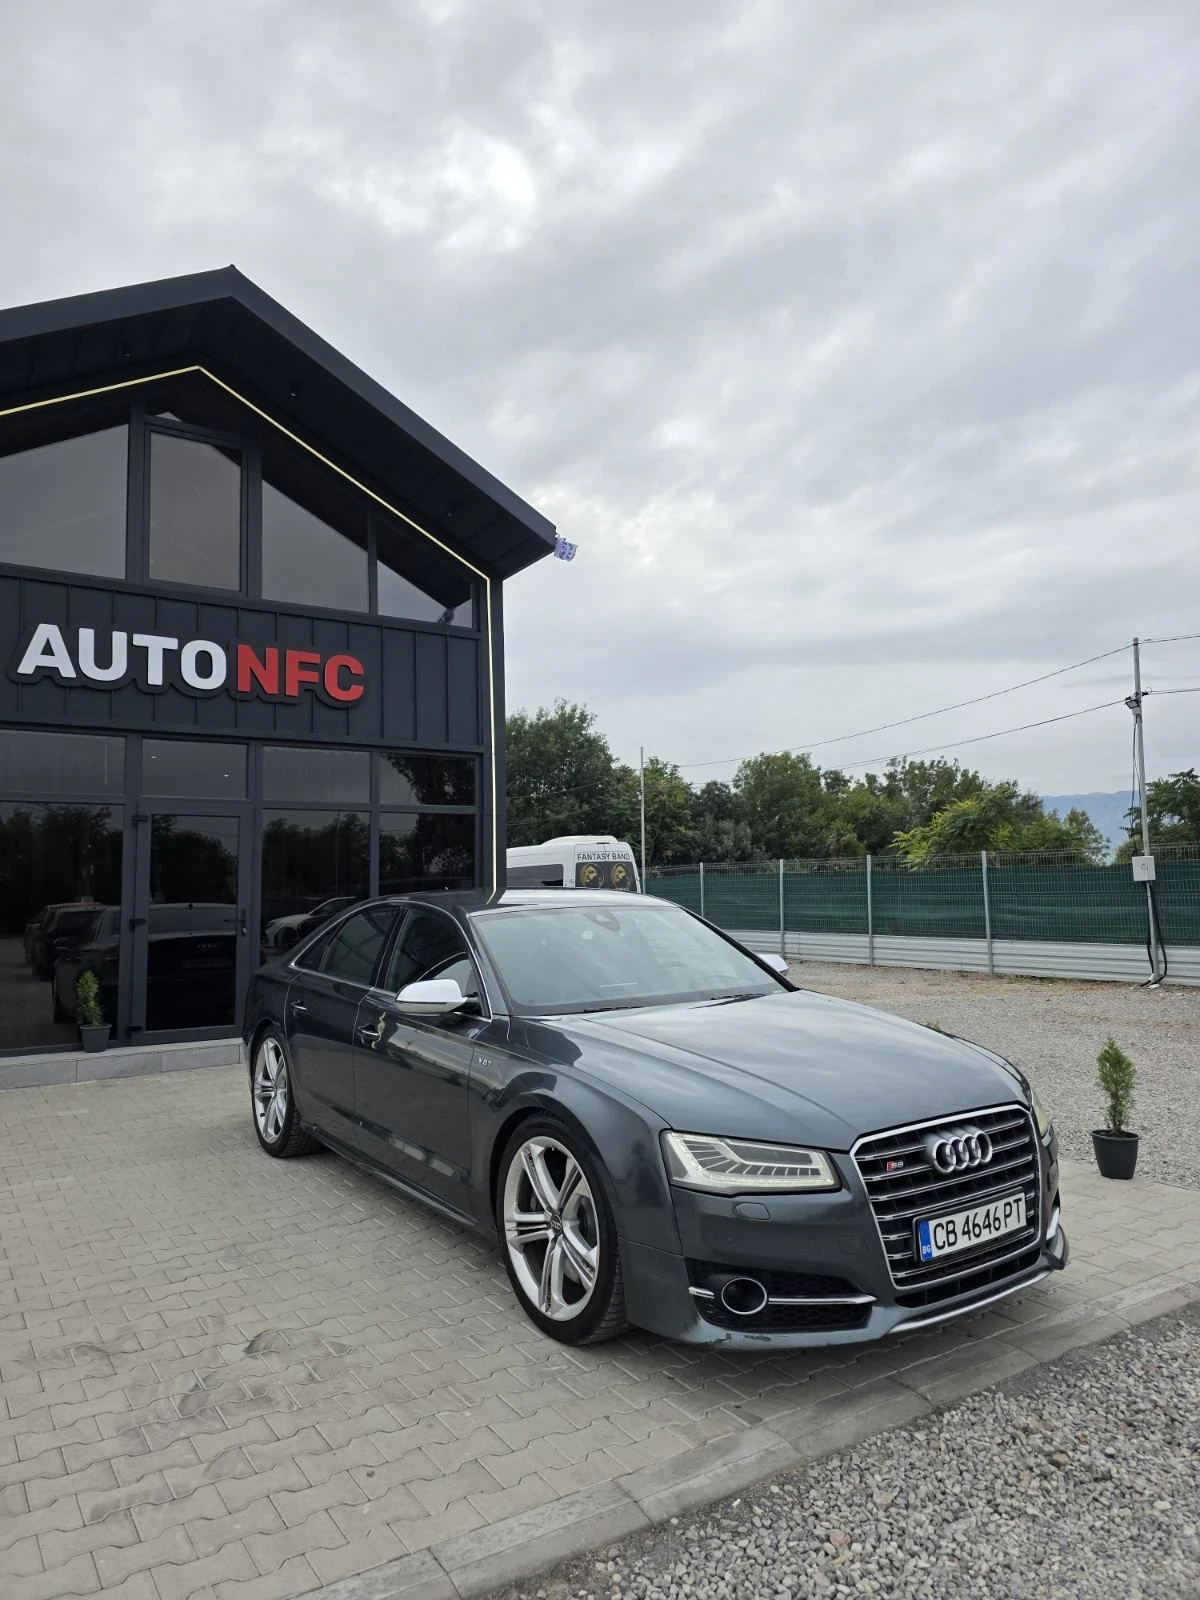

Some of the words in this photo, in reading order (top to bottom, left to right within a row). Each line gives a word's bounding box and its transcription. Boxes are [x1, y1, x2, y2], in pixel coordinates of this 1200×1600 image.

[577, 852, 610, 861] FANTASY
[612, 852, 631, 860] BAND
[922, 1245, 931, 1254] BG
